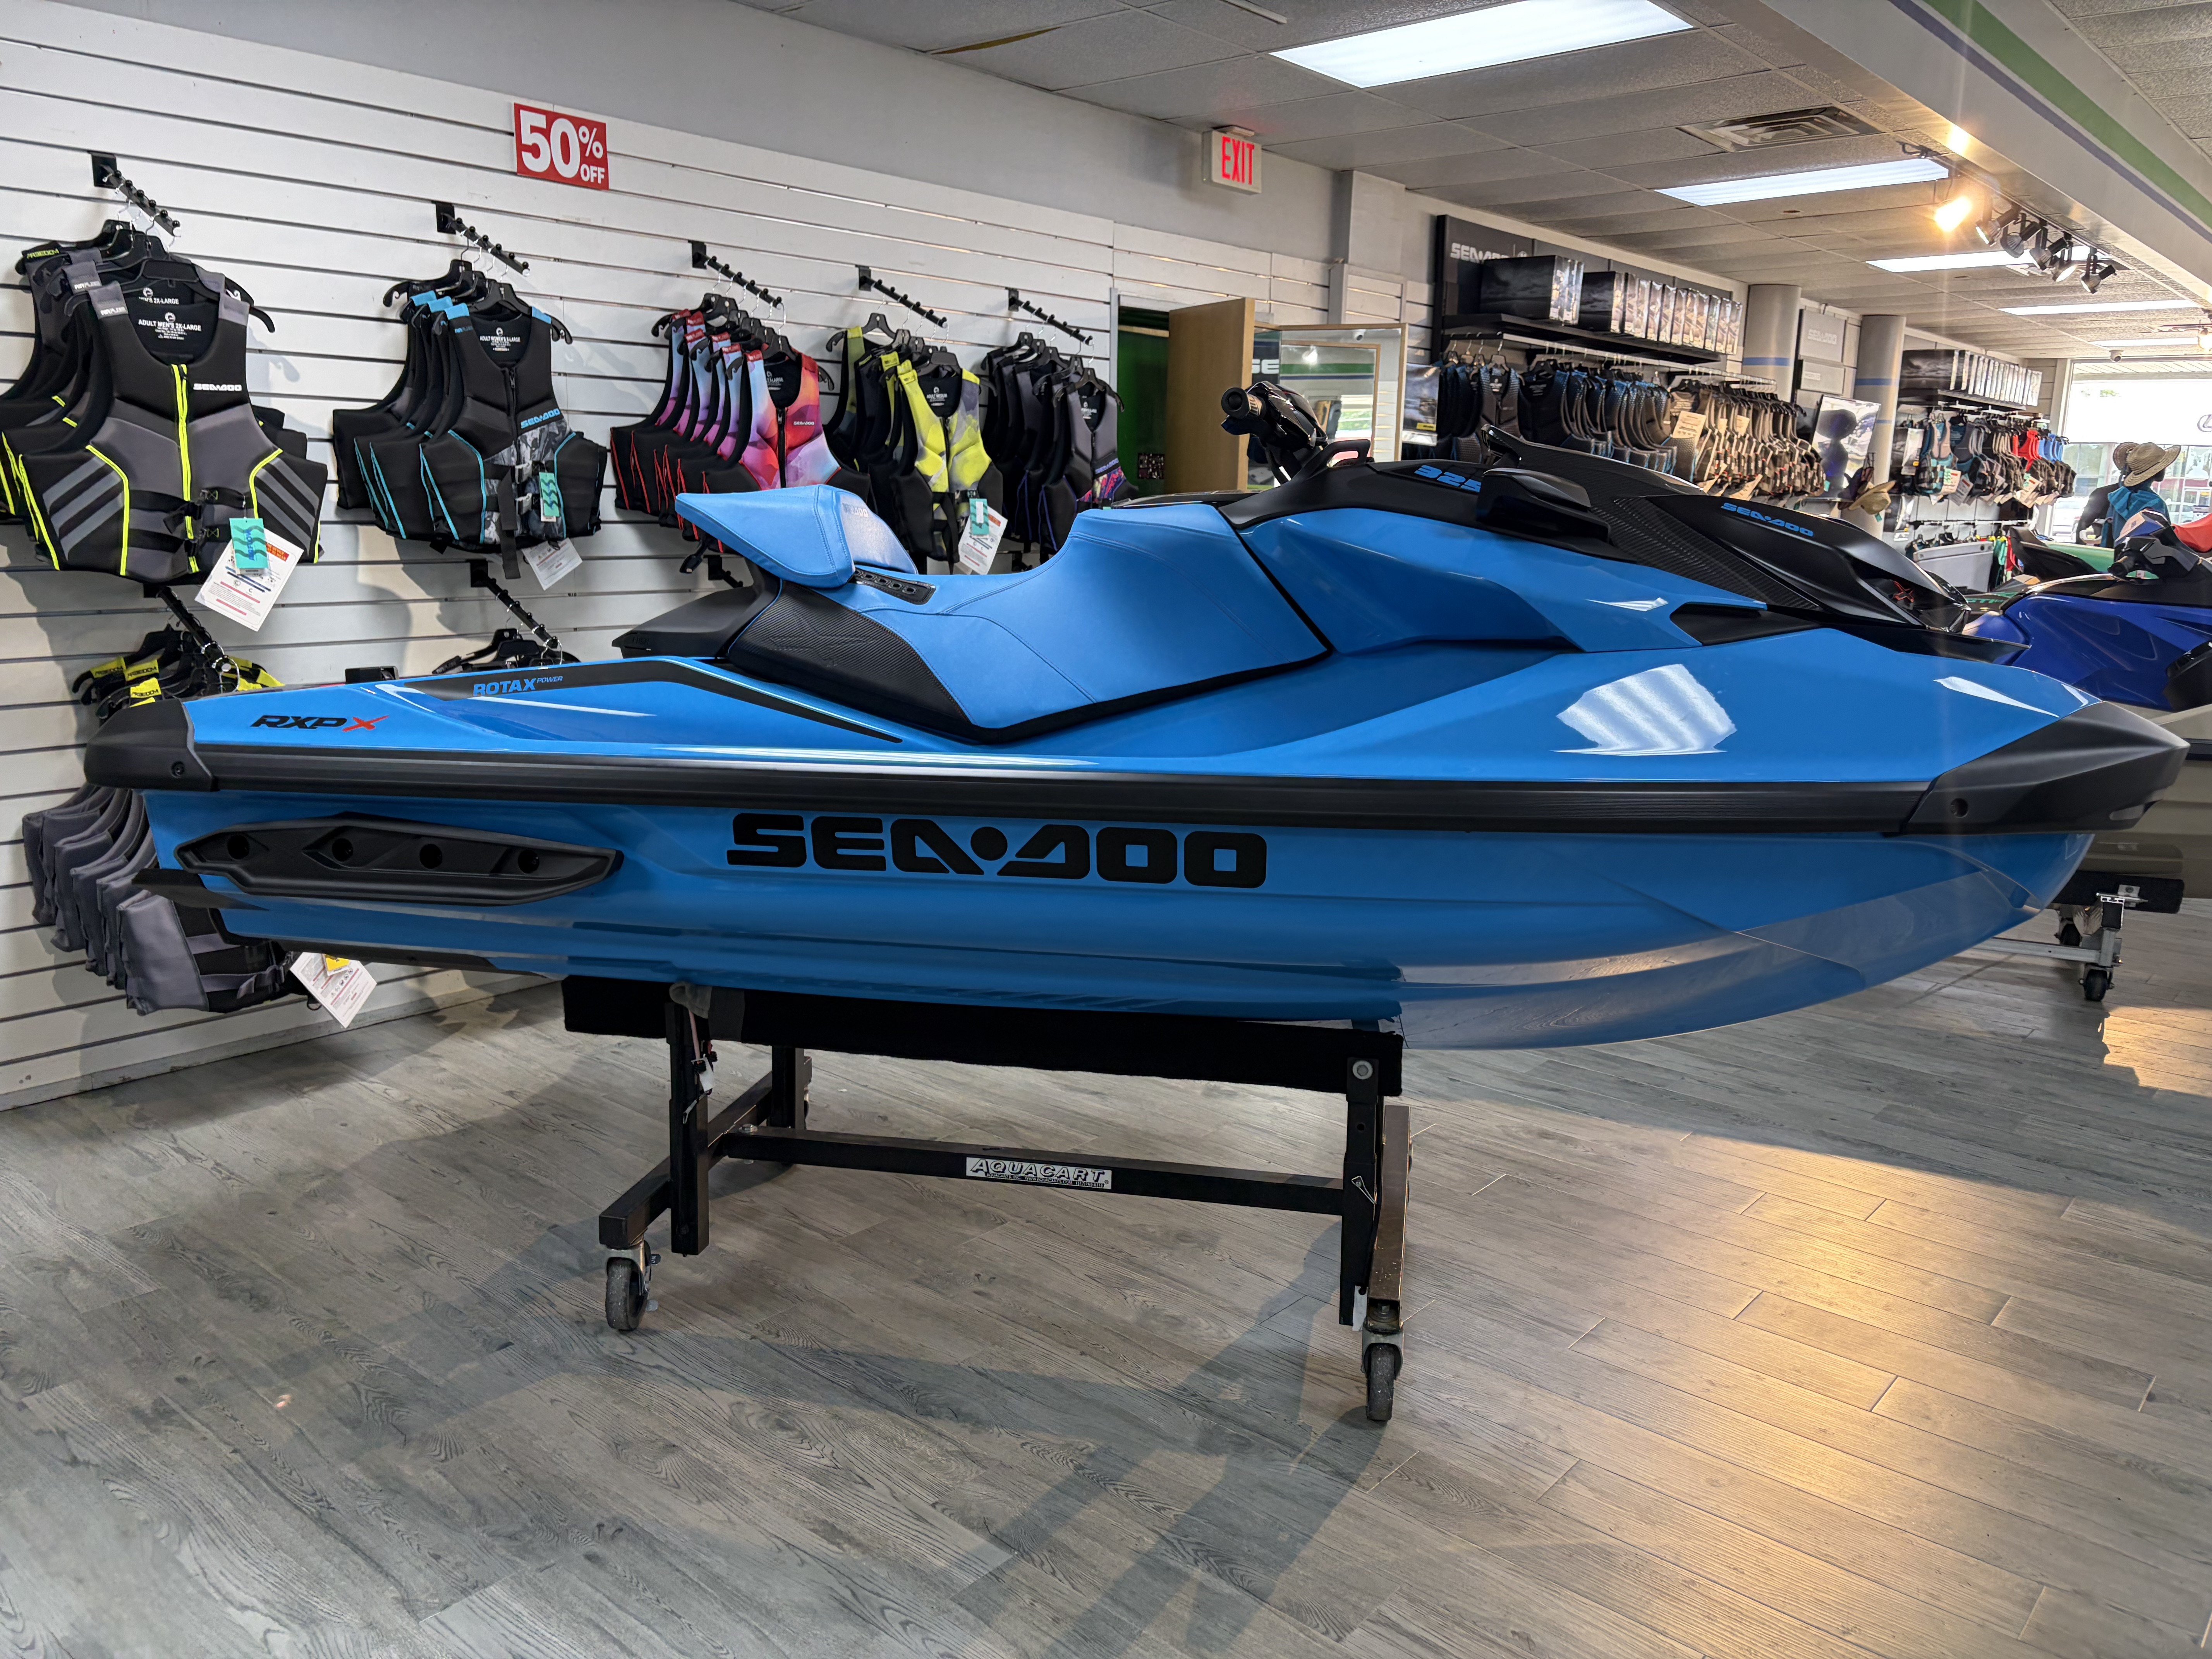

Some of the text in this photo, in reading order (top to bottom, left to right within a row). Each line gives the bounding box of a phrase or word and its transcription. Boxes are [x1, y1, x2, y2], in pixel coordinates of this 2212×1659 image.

[520, 109, 603, 178] 50%
[1222, 136, 1255, 185] EXIT
[580, 164, 605, 184] OFF
[175, 323, 202, 331] 2X-LARGE
[473, 676, 563, 697] ROTAX POWER
[970, 1158, 1105, 1182] AQUACART
